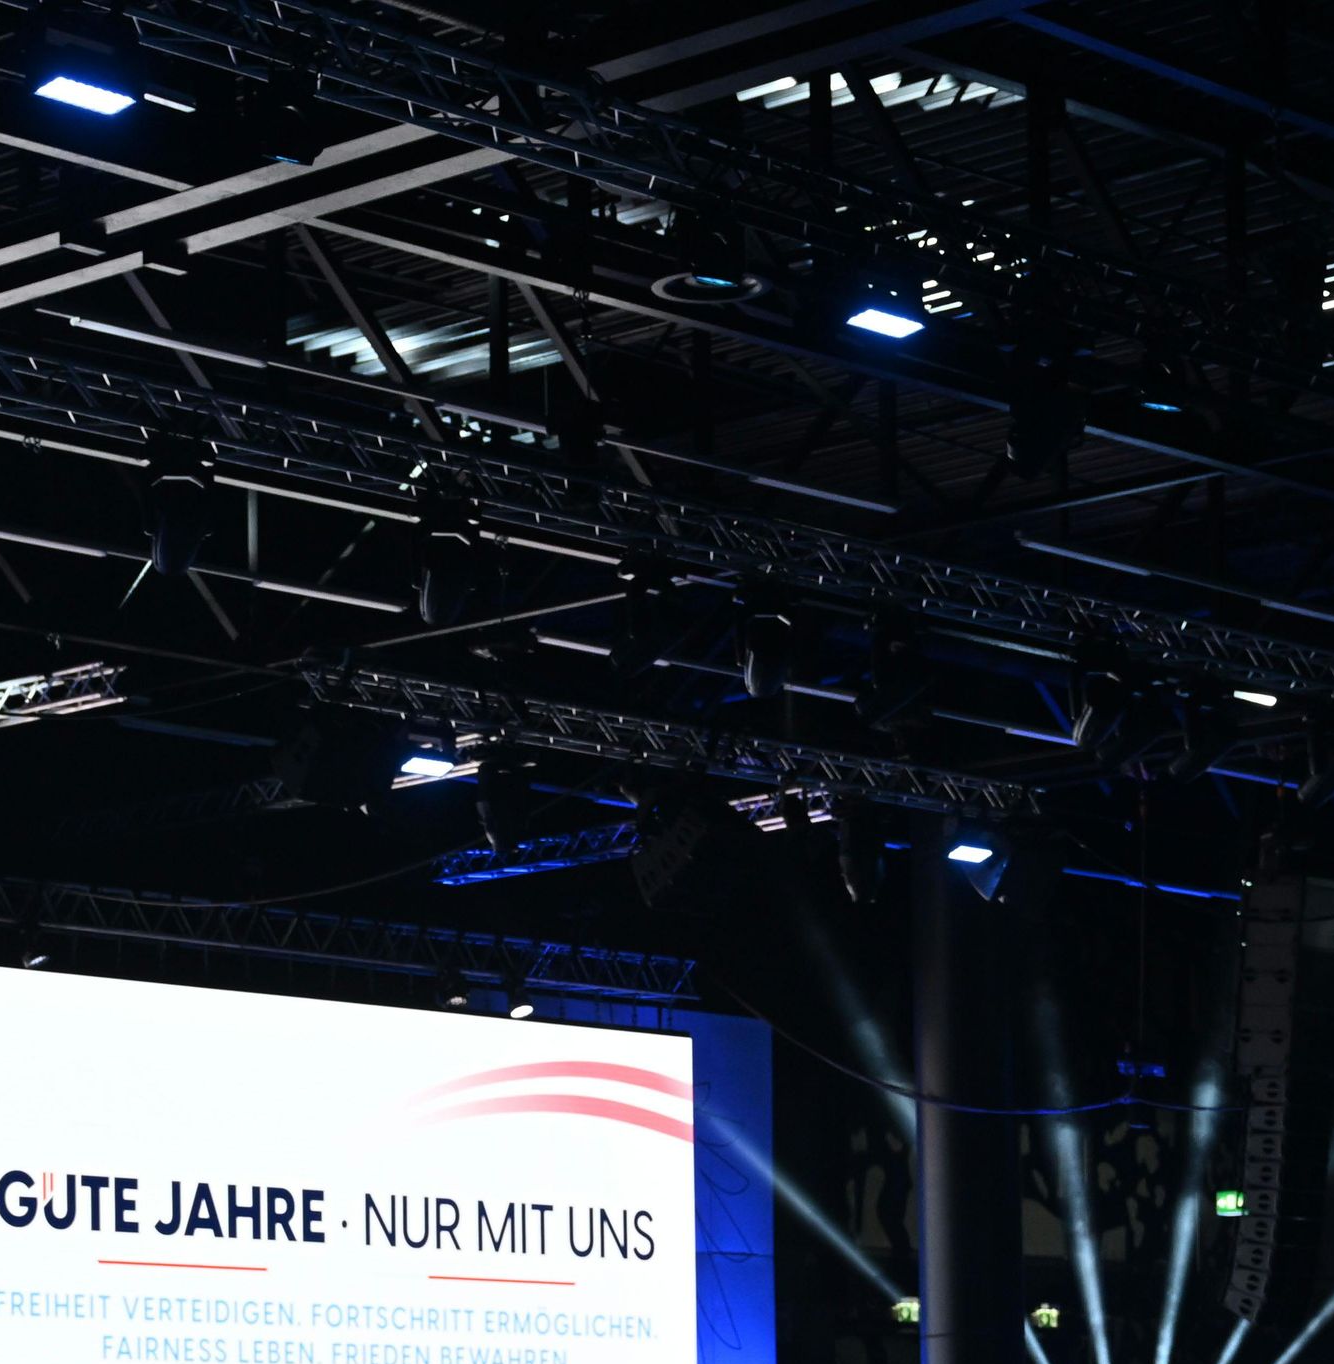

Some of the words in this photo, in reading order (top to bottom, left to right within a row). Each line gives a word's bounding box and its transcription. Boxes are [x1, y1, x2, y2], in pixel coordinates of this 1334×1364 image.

[154, 1180, 326, 1244] JAHRE
[364, 1192, 462, 1251] NUR
[477, 1199, 554, 1256] MIT
[568, 1205, 655, 1261] UNS
[122, 1296, 302, 1327] VERTEIDIGEN.
[310, 1302, 476, 1332] FORTSCHRITT
[483, 1307, 658, 1340] ERMÖGLICHEN.
[101, 1334, 228, 1364] FAIRNESS
